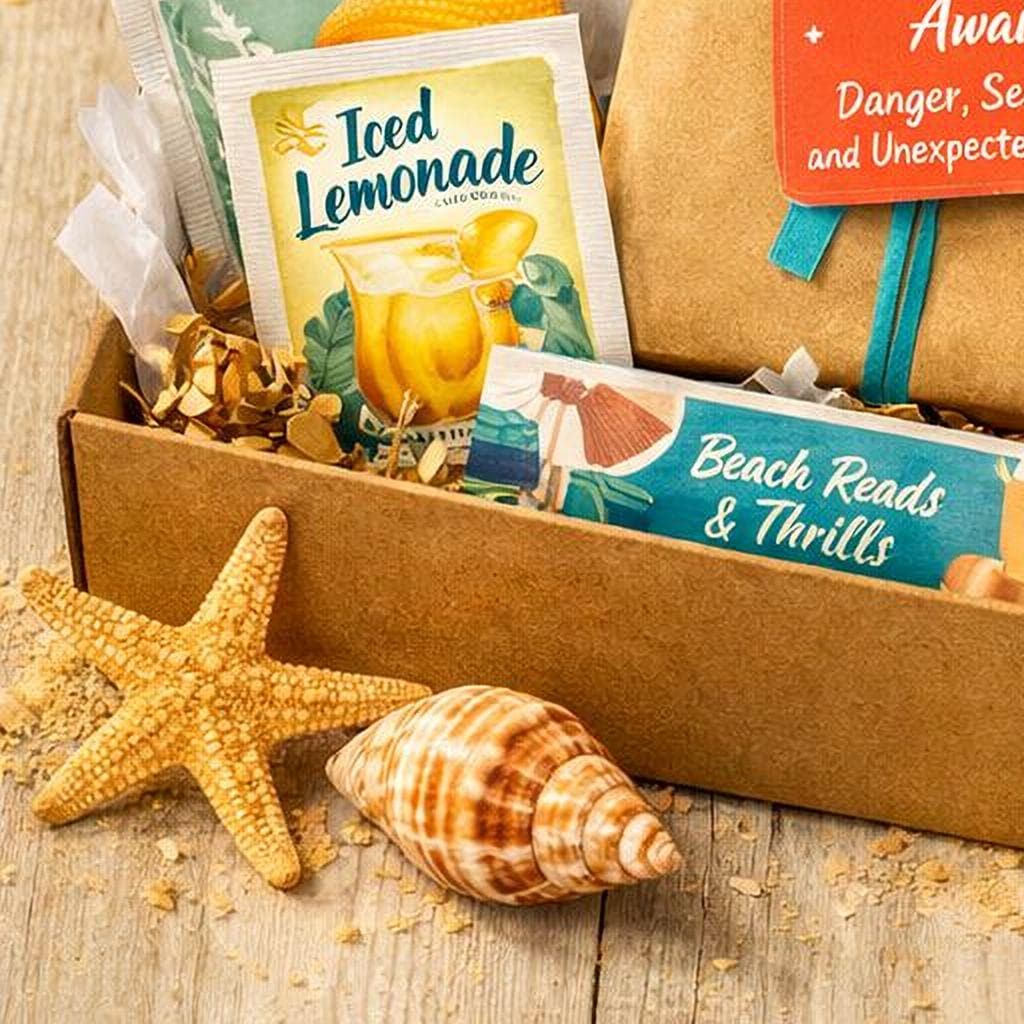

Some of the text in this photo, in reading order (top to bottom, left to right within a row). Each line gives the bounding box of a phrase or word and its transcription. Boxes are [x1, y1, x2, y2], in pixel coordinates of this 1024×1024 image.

[336, 86, 439, 167] Iced
[836, 81, 970, 128] Danger,
[295, 122, 544, 240] Lemonade
[808, 135, 860, 171] and
[691, 432, 946, 518] Beach Reads
[704, 496, 894, 567] & Thrills
